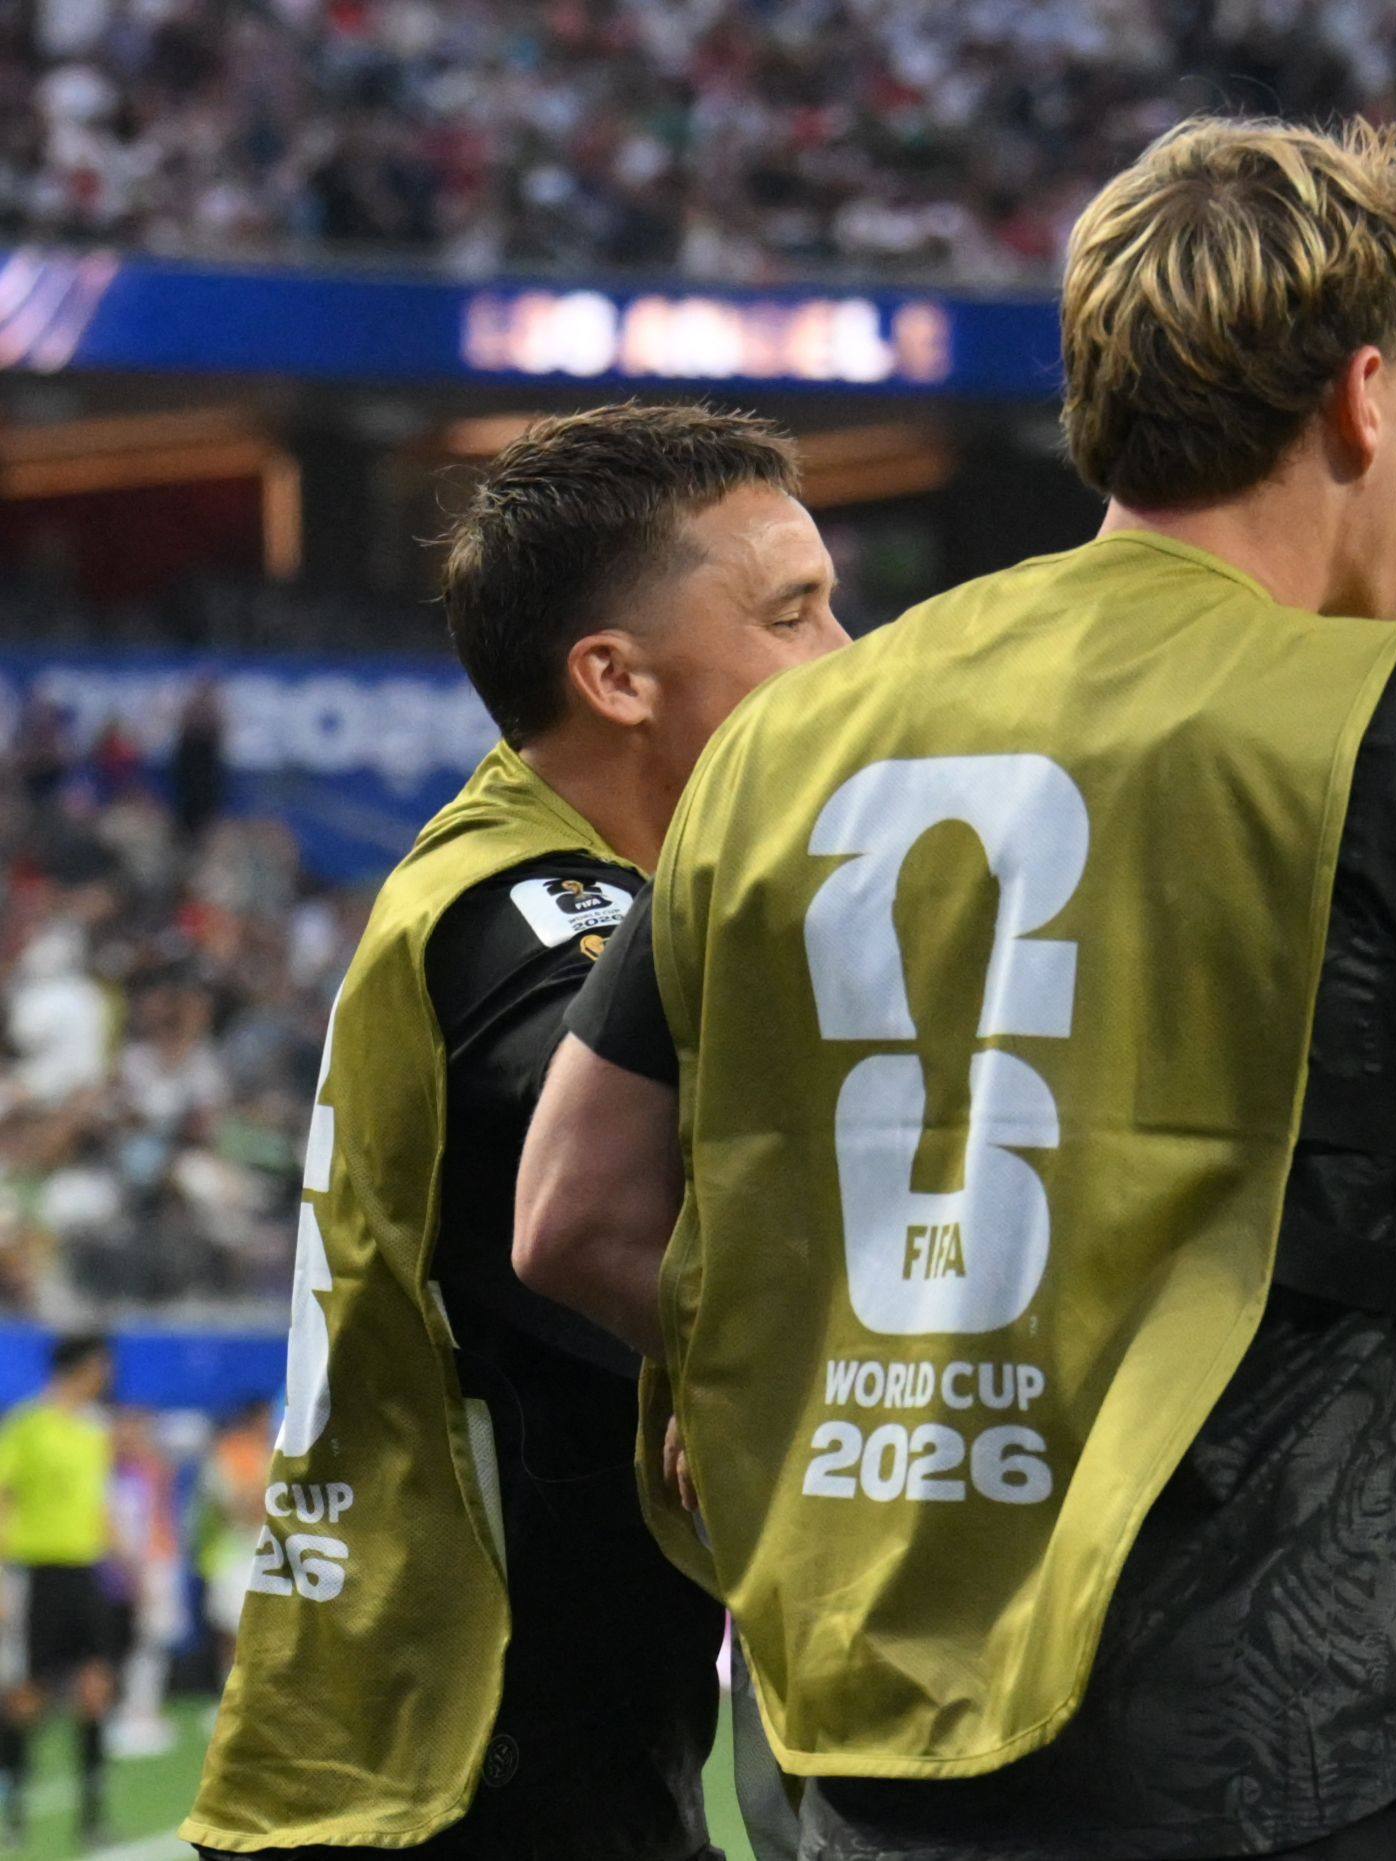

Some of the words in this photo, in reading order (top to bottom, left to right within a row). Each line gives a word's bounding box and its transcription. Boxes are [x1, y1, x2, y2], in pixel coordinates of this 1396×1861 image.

[572, 914, 624, 932] 2026
[575, 898, 601, 910] FIFA
[902, 1222, 966, 1280] FIFA
[825, 1359, 935, 1408] WORLD
[941, 1361, 1045, 1411] CUP
[802, 1420, 1053, 1504] 2026
[265, 1481, 354, 1523] CUP
